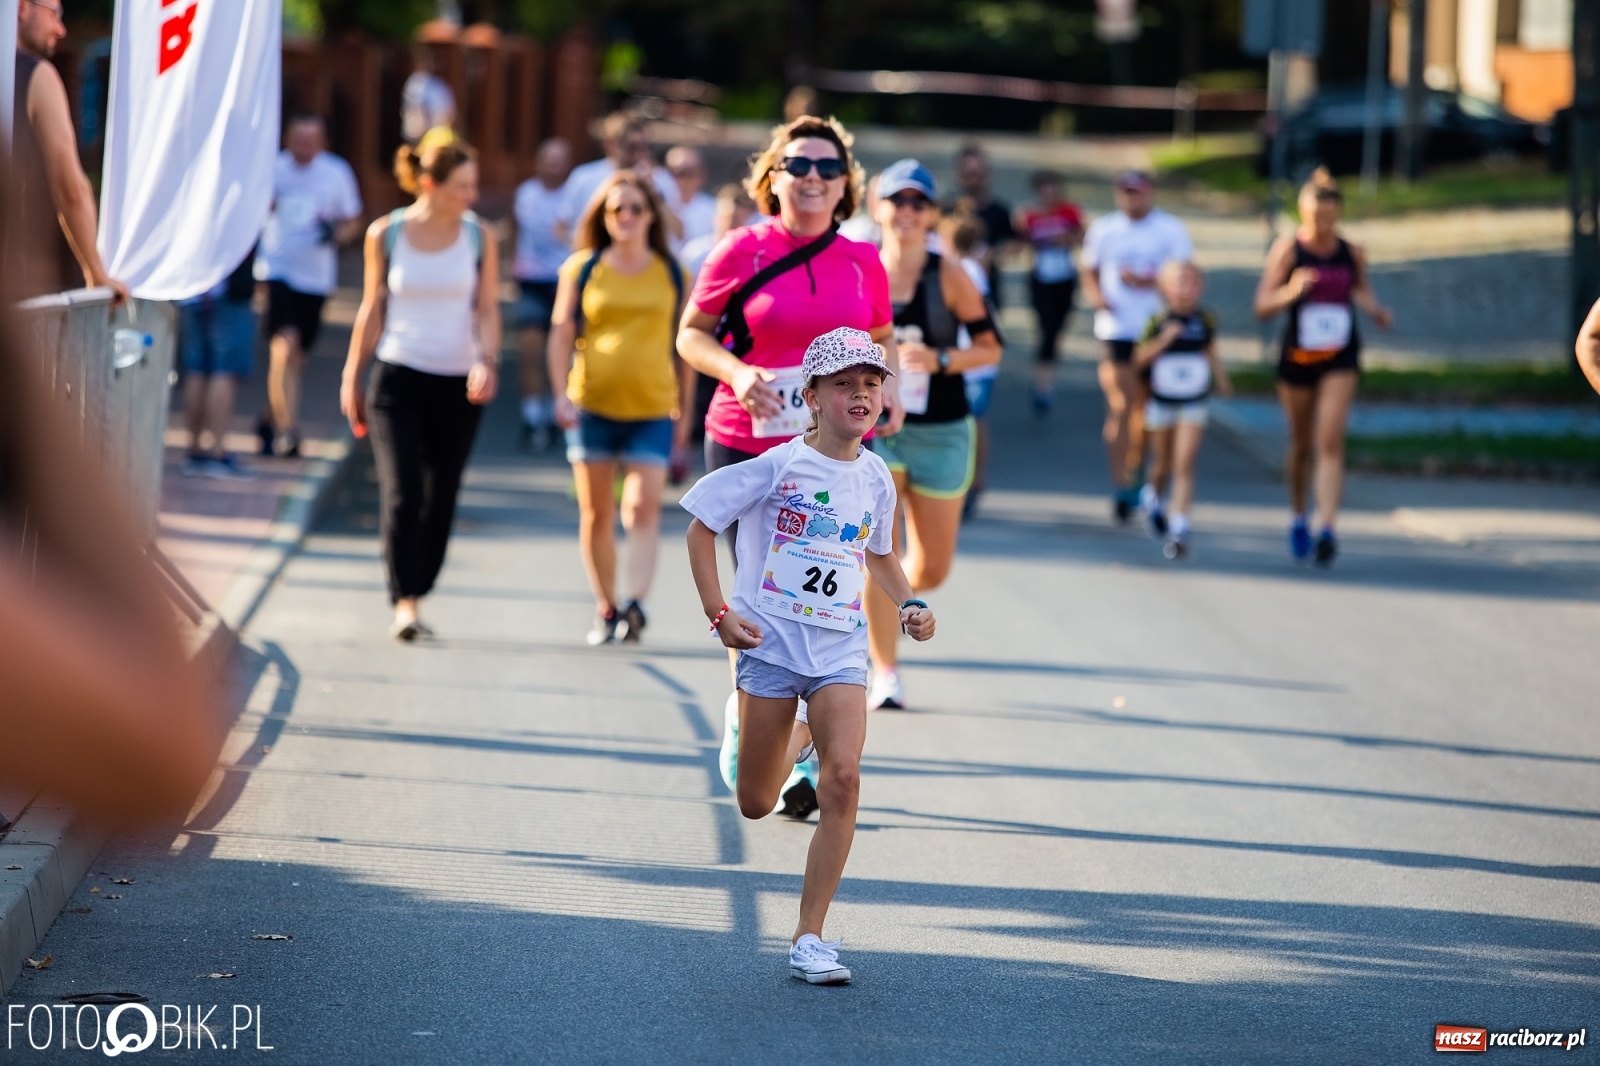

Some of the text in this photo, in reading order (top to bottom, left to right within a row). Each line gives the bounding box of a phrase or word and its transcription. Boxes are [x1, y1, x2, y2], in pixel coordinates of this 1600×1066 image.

[803, 547, 845, 560] MINI RAFAKO
[801, 565, 838, 597] 26
